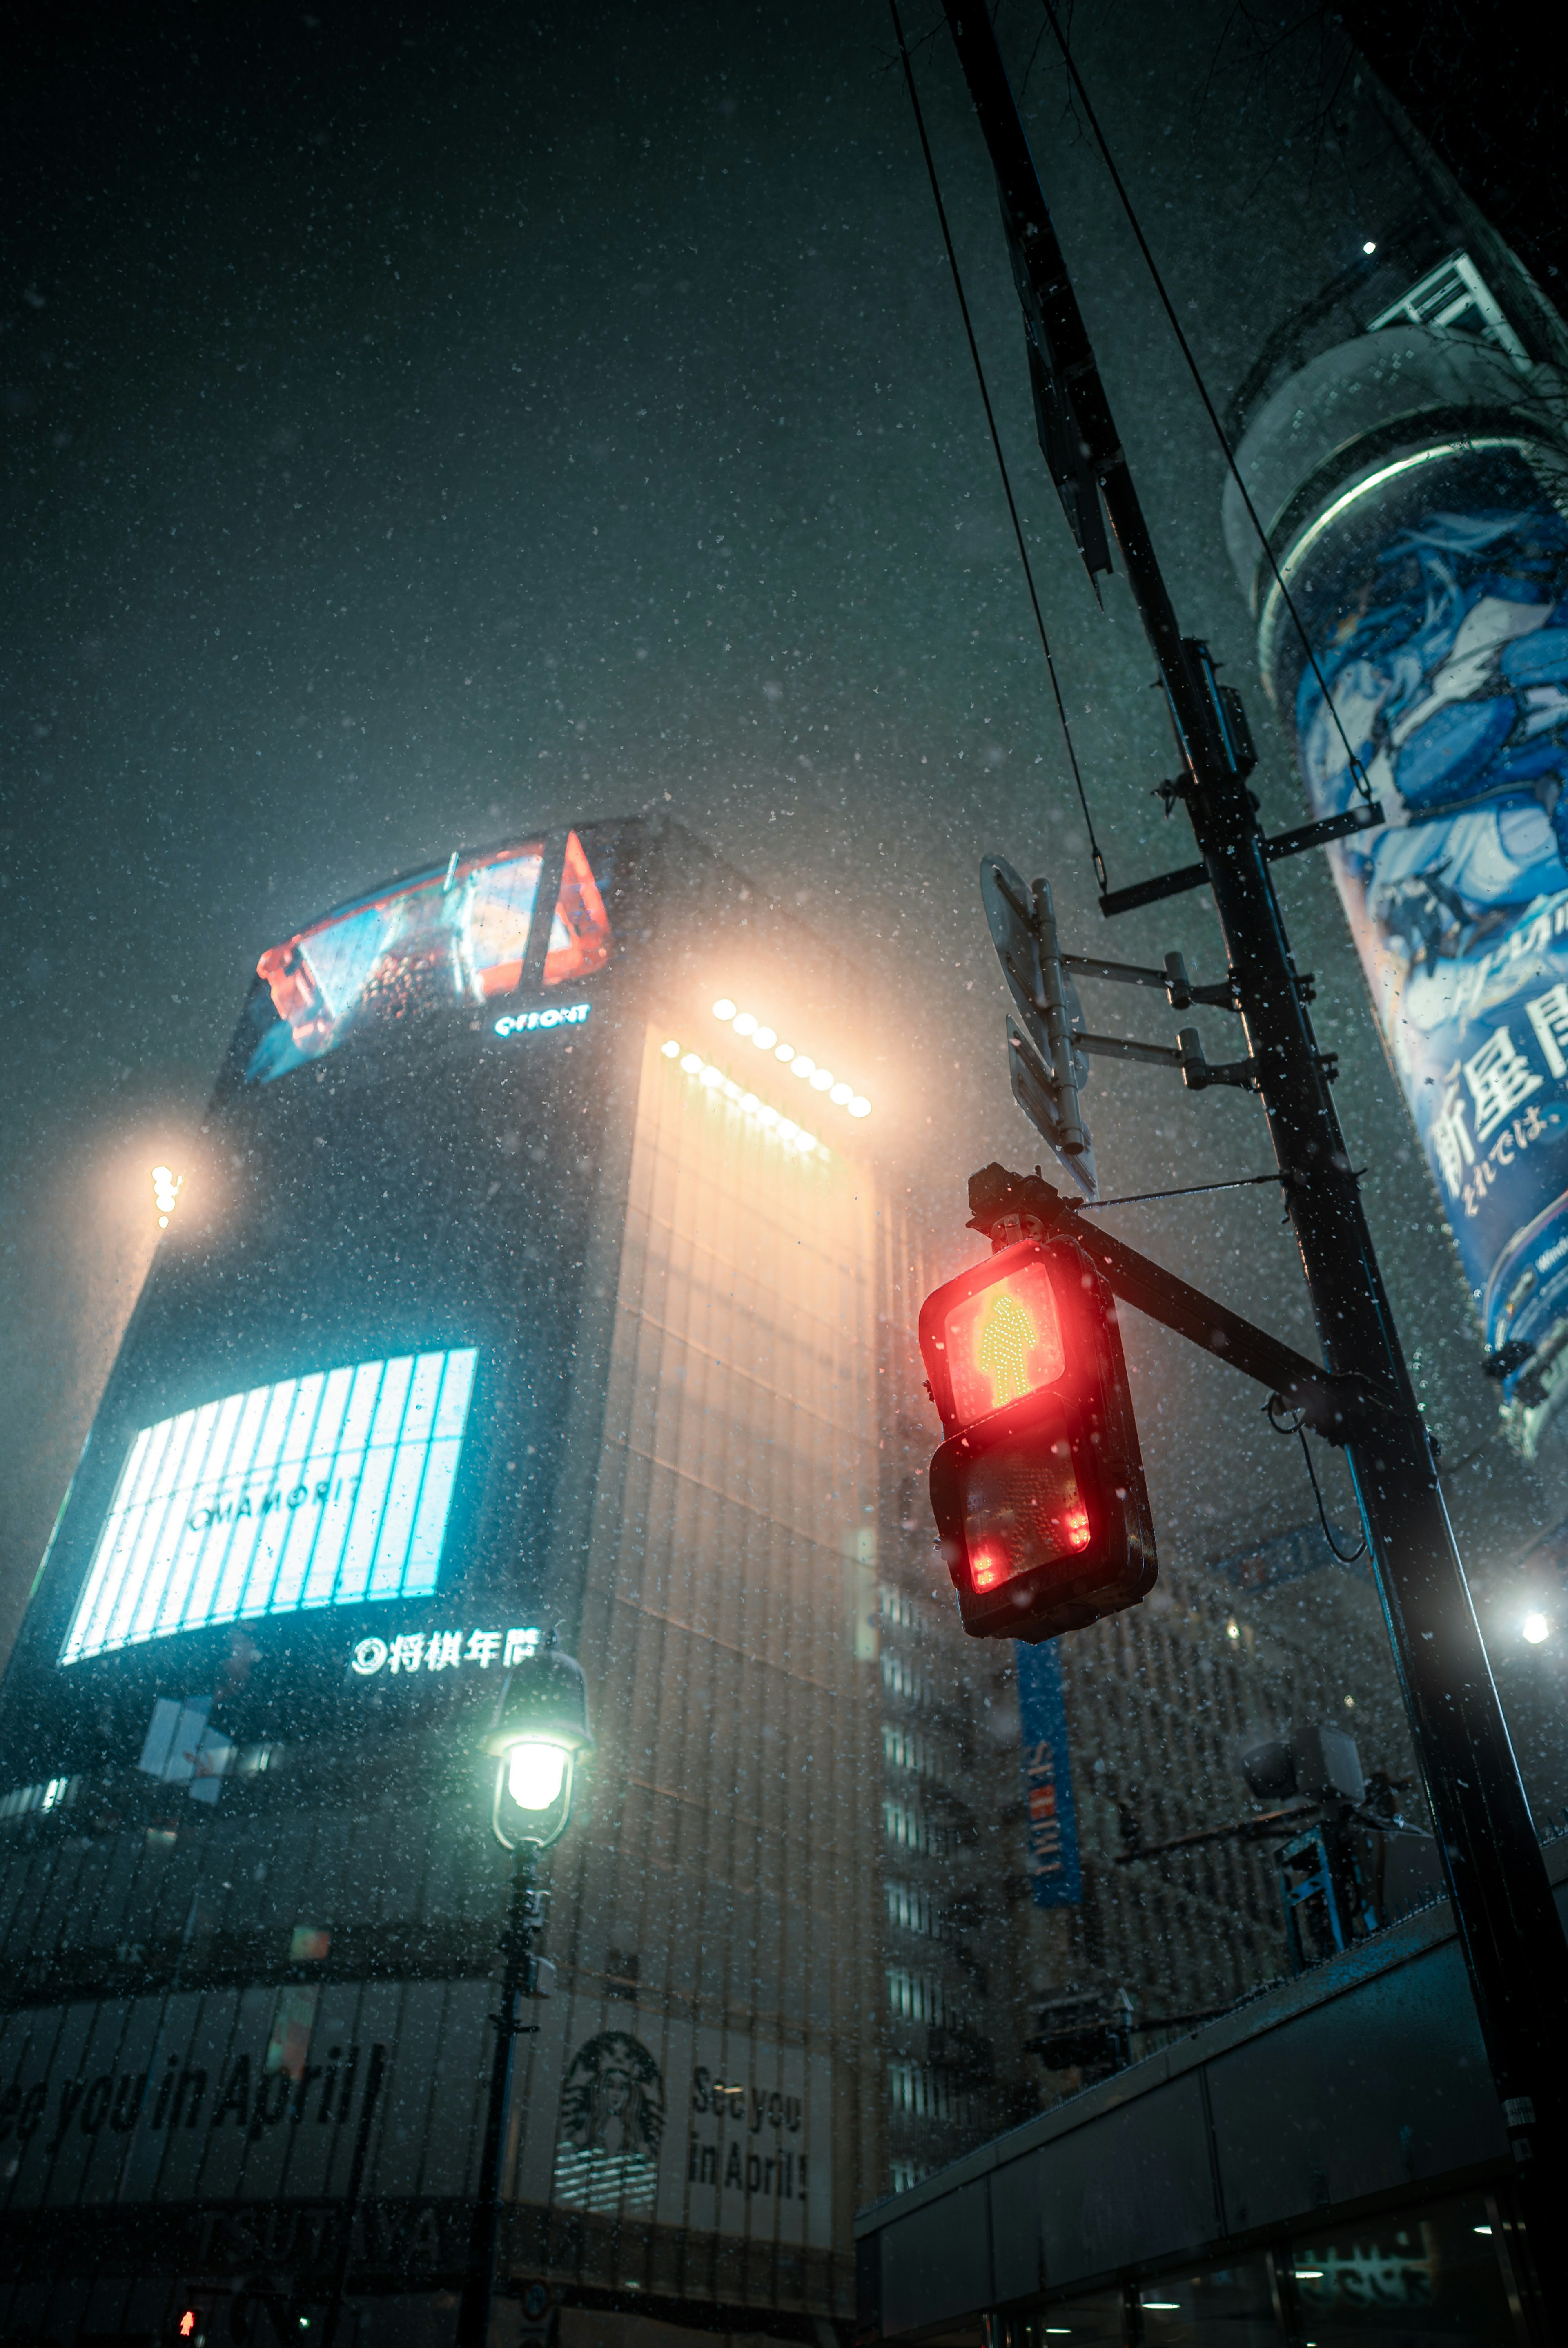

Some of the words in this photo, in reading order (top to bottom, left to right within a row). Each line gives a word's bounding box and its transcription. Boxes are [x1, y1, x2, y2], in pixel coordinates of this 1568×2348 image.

[46, 2074, 149, 2155] you
[150, 2054, 207, 2129] in
[693, 2066, 746, 2120] See
[750, 2086, 803, 2134] you
[688, 2129, 719, 2185] in
[724, 2142, 807, 2202] April!
